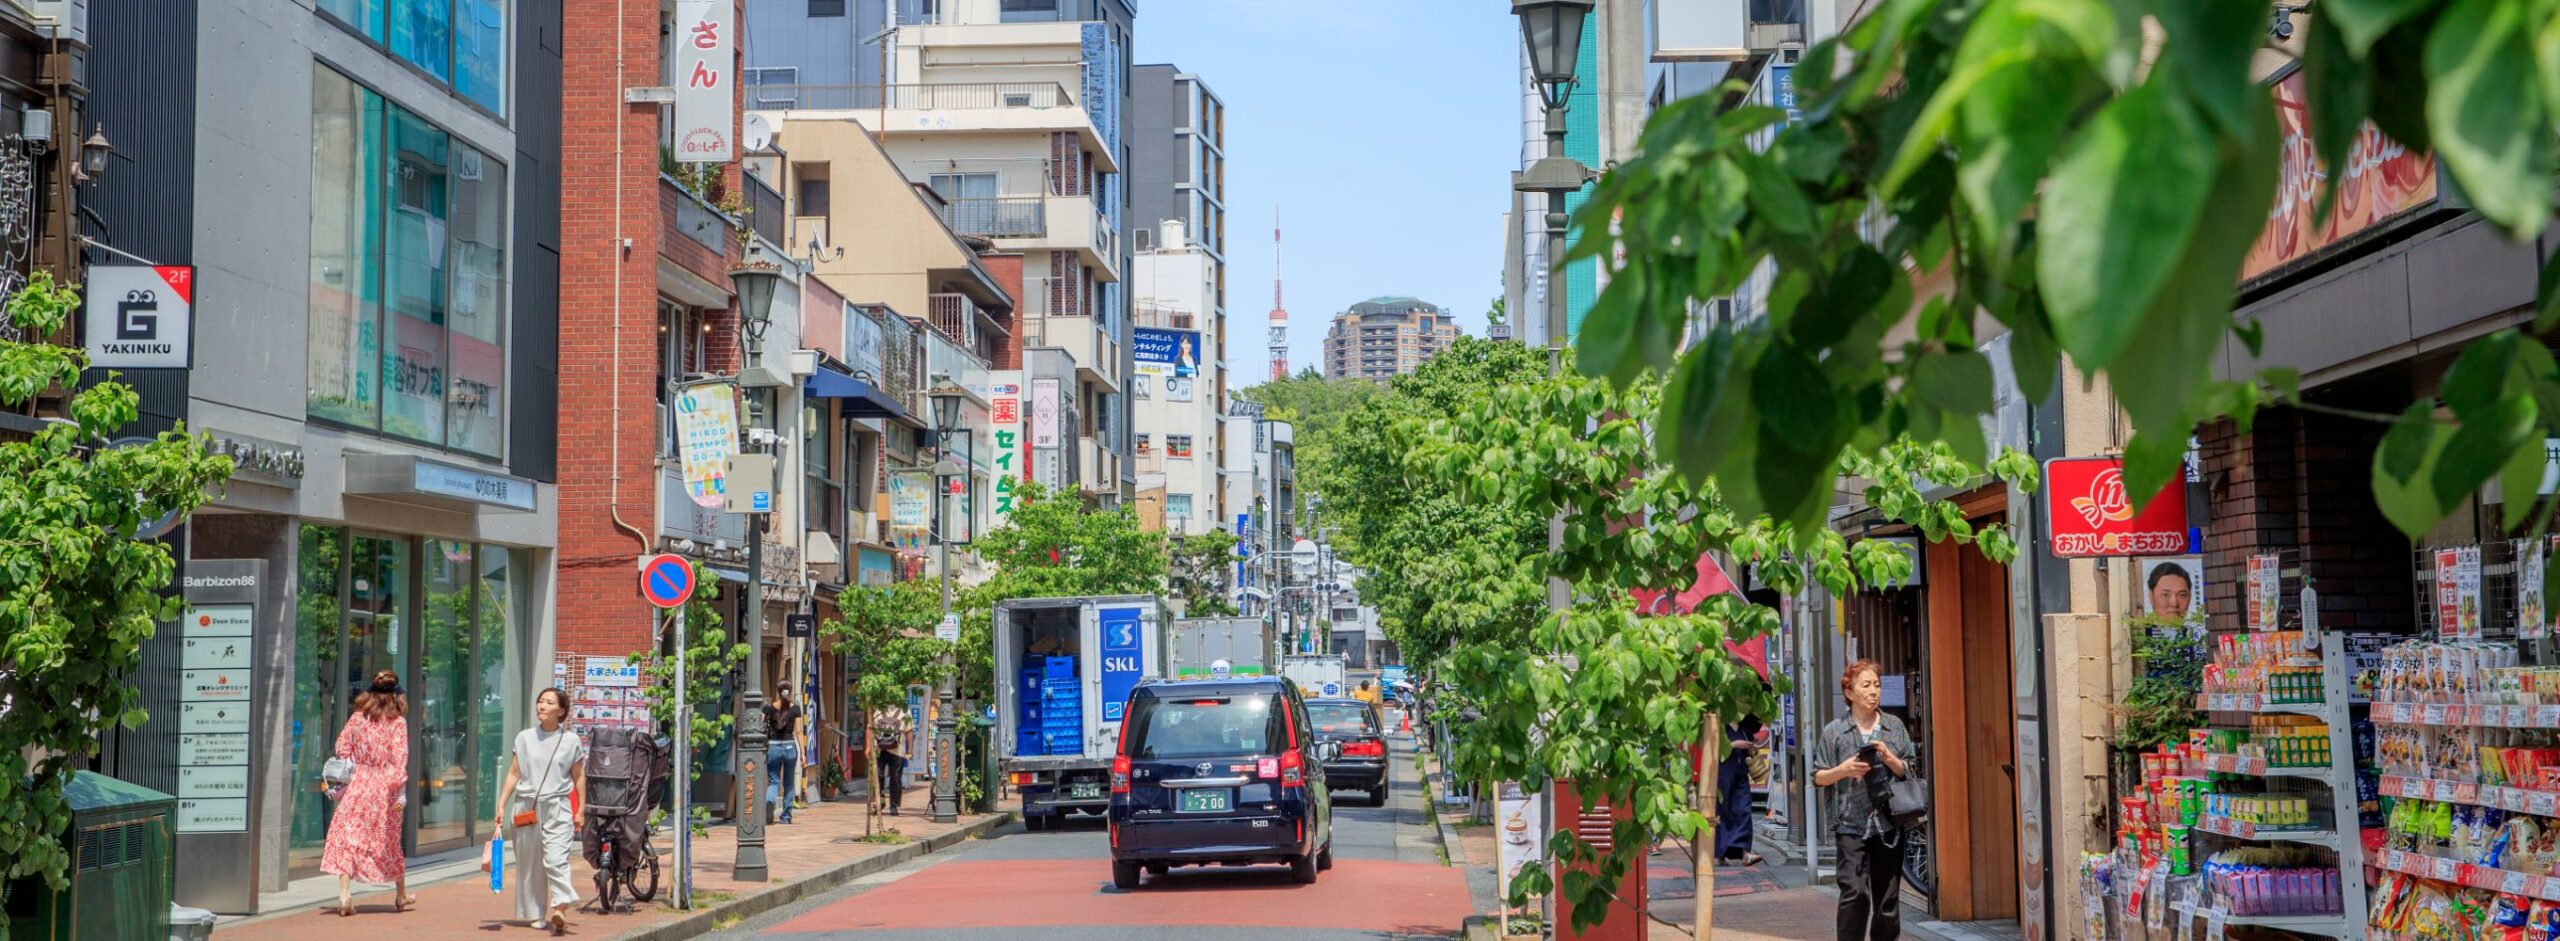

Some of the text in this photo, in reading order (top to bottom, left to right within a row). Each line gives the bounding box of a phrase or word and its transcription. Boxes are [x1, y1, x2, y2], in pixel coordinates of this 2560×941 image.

[690, 20, 719, 89] さん
[169, 270, 189, 283] 2F
[102, 344, 171, 354] YAKINIKU
[995, 401, 1015, 421] 薬
[690, 427, 726, 438] HIROO
[691, 439, 727, 449] SAMPO
[995, 430, 1015, 515] セイムス
[183, 576, 255, 588] Barbizon86
[1105, 657, 1139, 673] SKL
[1252, 819, 1269, 828] km
